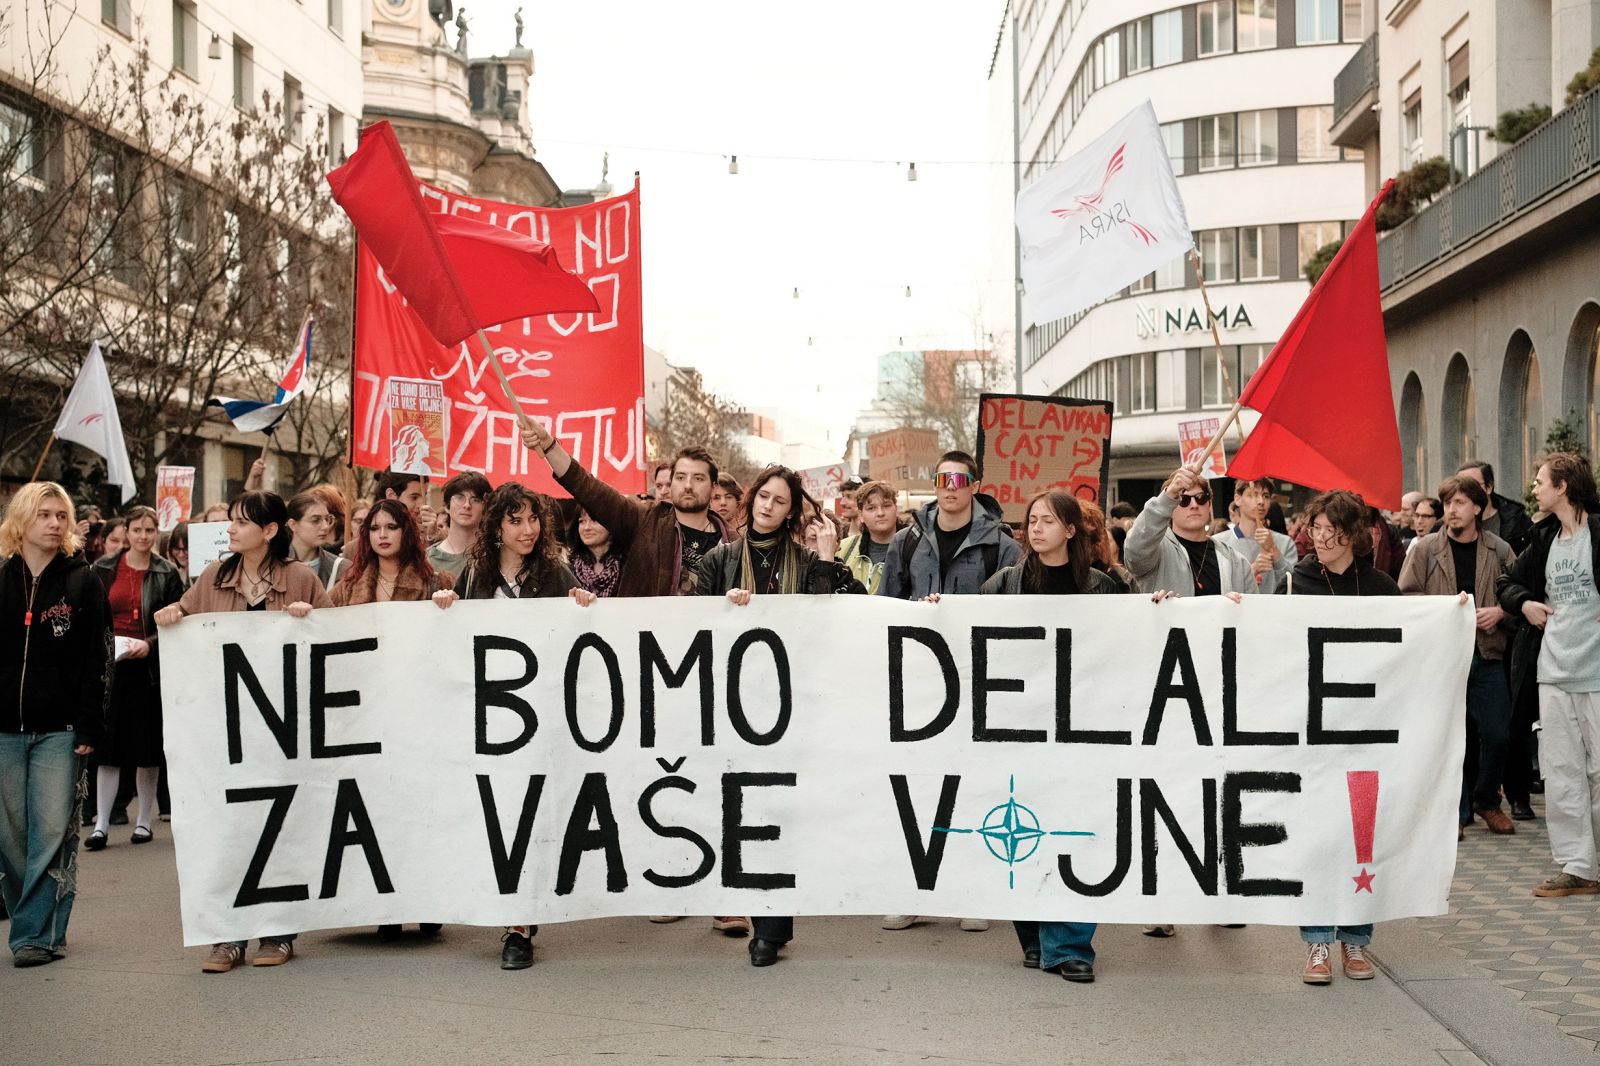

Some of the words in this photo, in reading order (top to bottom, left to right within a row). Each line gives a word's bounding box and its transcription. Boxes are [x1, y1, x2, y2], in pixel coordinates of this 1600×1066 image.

[1166, 303, 1252, 333] NAMA
[1009, 460, 1040, 481] IN
[222, 637, 382, 764] NE
[473, 627, 792, 756] BOMO
[887, 625, 1403, 746] DELALE
[225, 778, 394, 908] ZA
[475, 756, 797, 897] VAŠE
